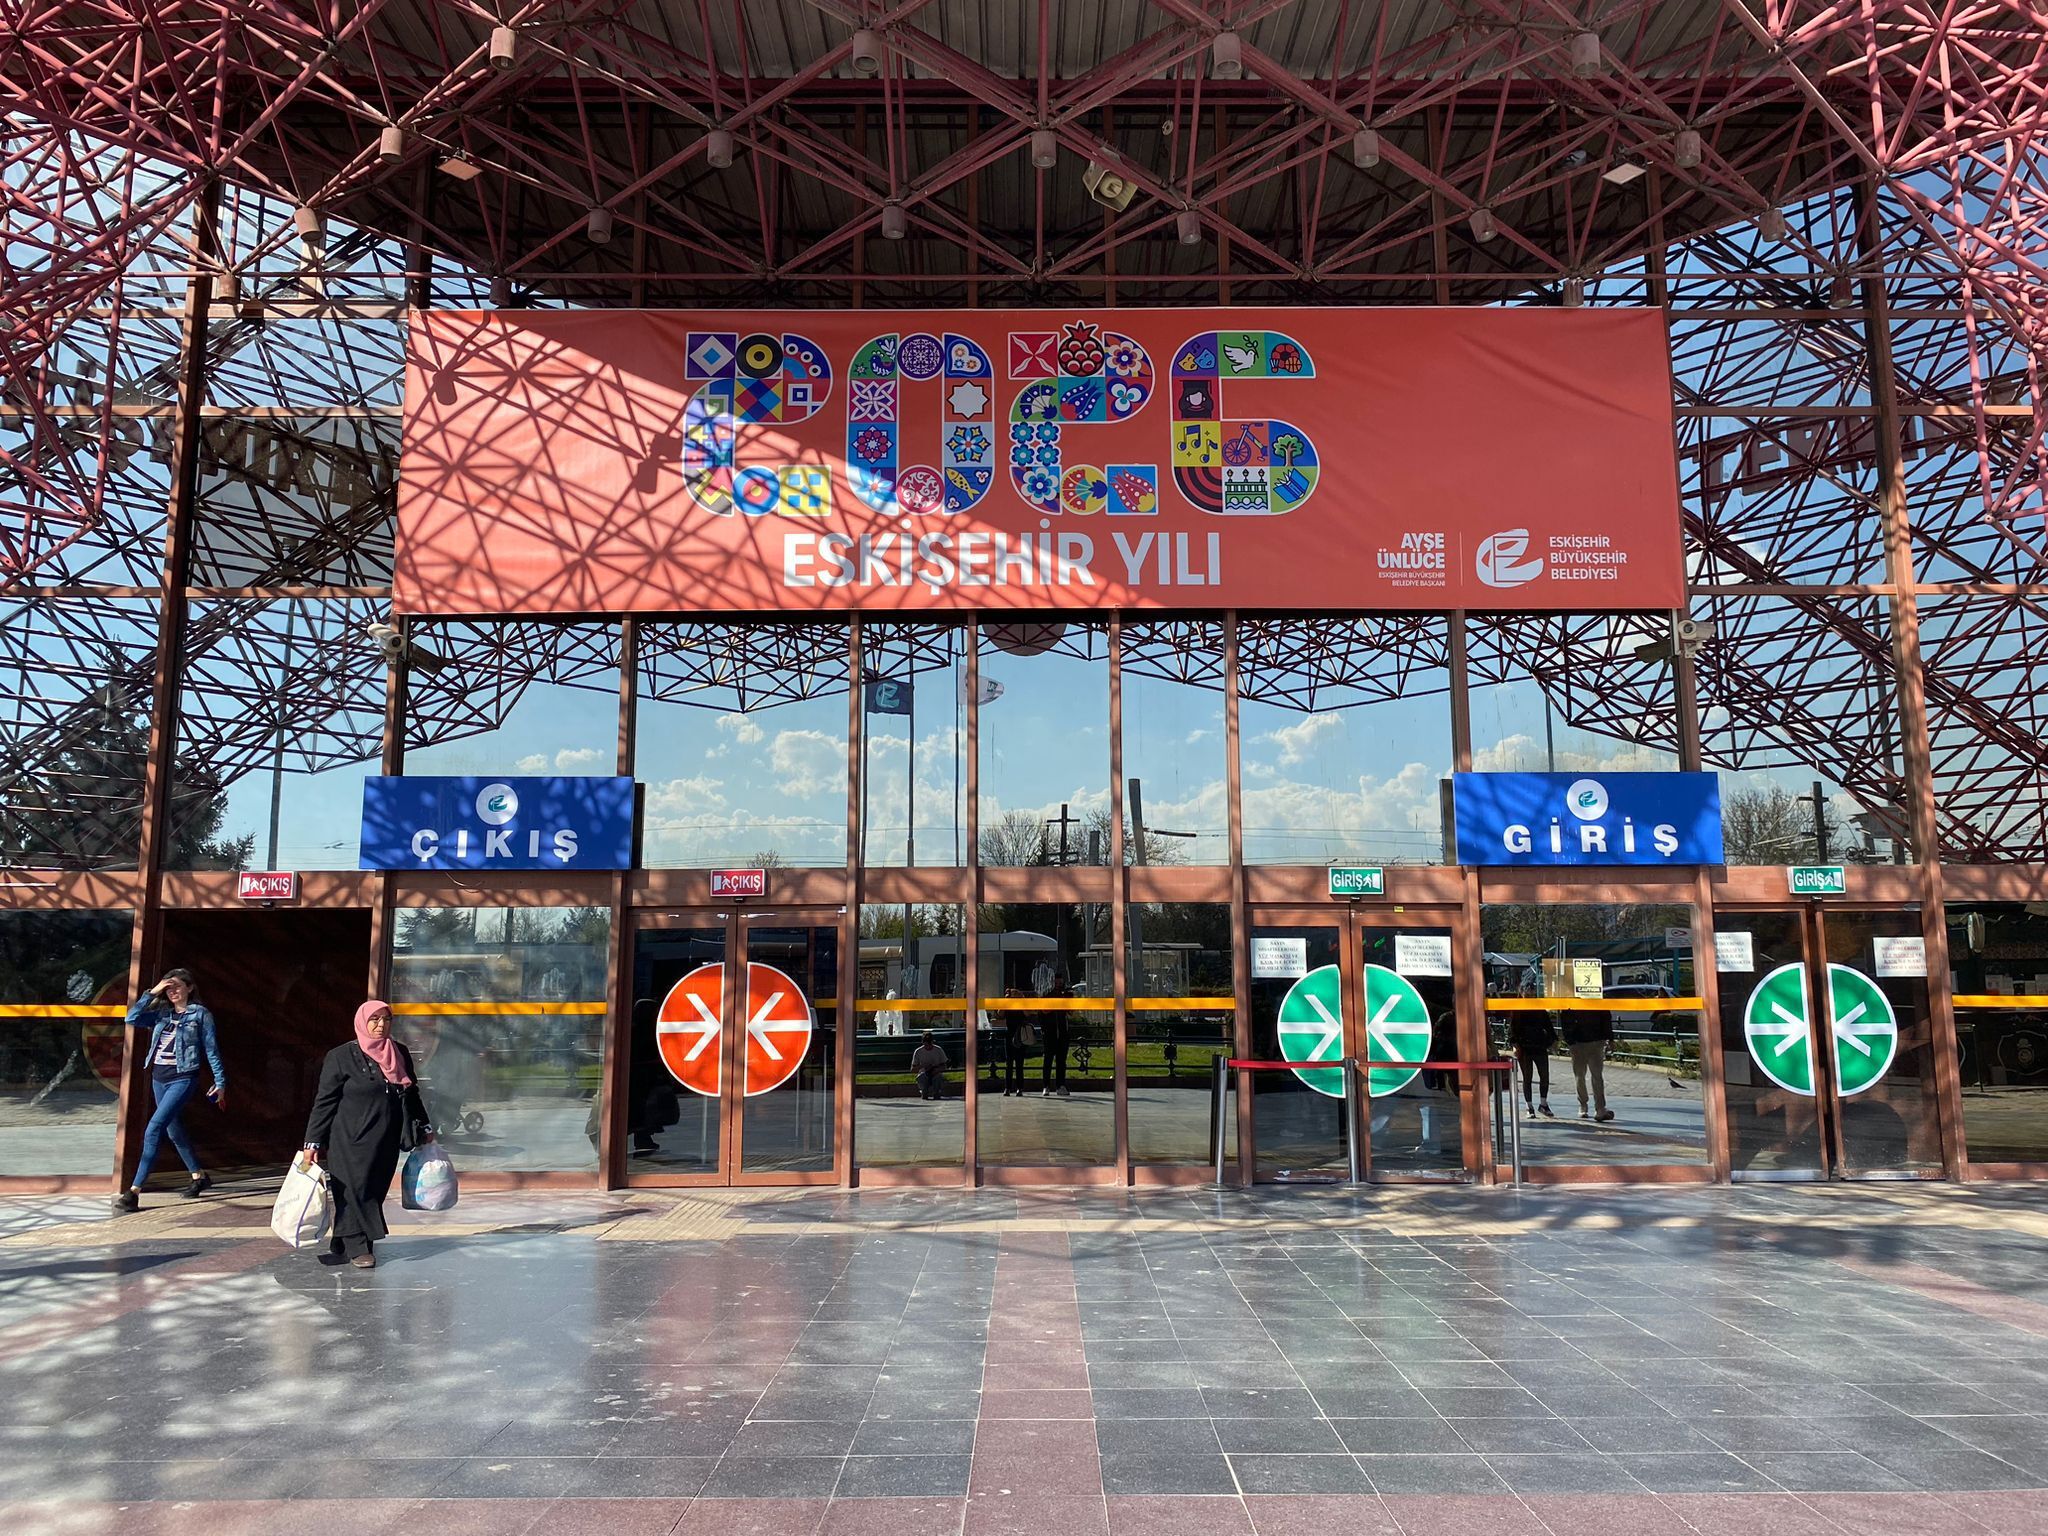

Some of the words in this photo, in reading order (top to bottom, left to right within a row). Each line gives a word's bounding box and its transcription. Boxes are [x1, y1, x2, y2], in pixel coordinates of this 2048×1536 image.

[681, 320, 1320, 516] 2026
[1401, 532, 1445, 552] AYŞE
[1549, 534, 1611, 549] ESKİŞEHİR
[783, 518, 1096, 596] ESKİŞEHİR
[1112, 532, 1221, 586] YILI
[1377, 548, 1445, 569] ÜNLÜCE
[1550, 550, 1628, 566] BÜYÜKŞEHİR
[1378, 571, 1408, 579] ESKİŞEHİR
[1392, 579, 1419, 587] BELEDİYE
[1419, 579, 1446, 587] BAŞKANI
[1551, 567, 1618, 580] BELEDİYESİ
[411, 828, 578, 862] ÇIKIŞ
[1503, 816, 1679, 857] GİRİŞ
[260, 877, 290, 895] ÇIKIŞ
[731, 875, 761, 892] ÇIKIŞ
[1332, 870, 1363, 890] GİRİŞ
[1794, 870, 1825, 890] GİRİŞ
